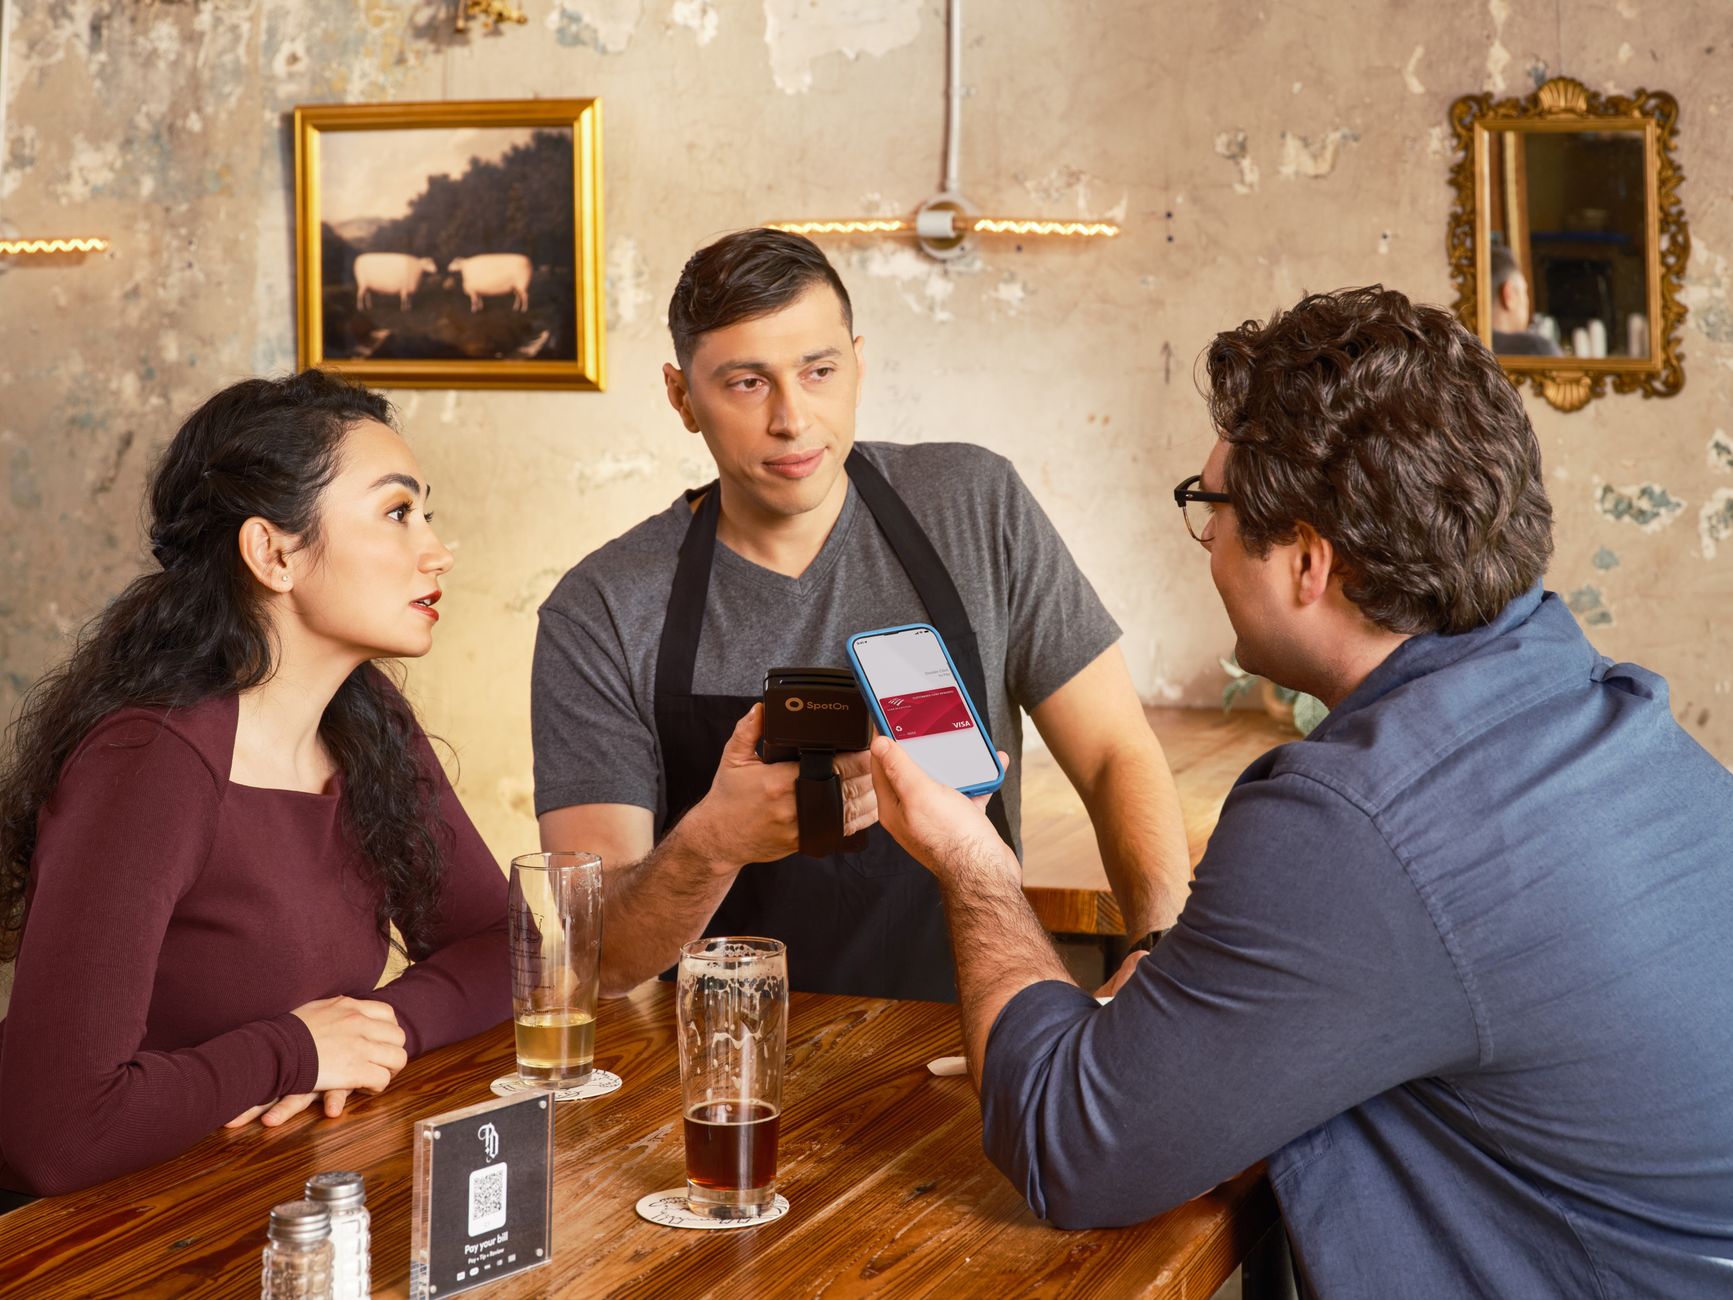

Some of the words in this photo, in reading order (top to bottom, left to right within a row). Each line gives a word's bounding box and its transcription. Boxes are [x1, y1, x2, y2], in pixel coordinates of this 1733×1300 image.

[806, 701, 849, 711] SpotOn
[952, 720, 971, 729] VISA
[464, 1244, 479, 1255] Pay
[480, 1237, 497, 1252] your
[497, 1231, 509, 1244] bill
